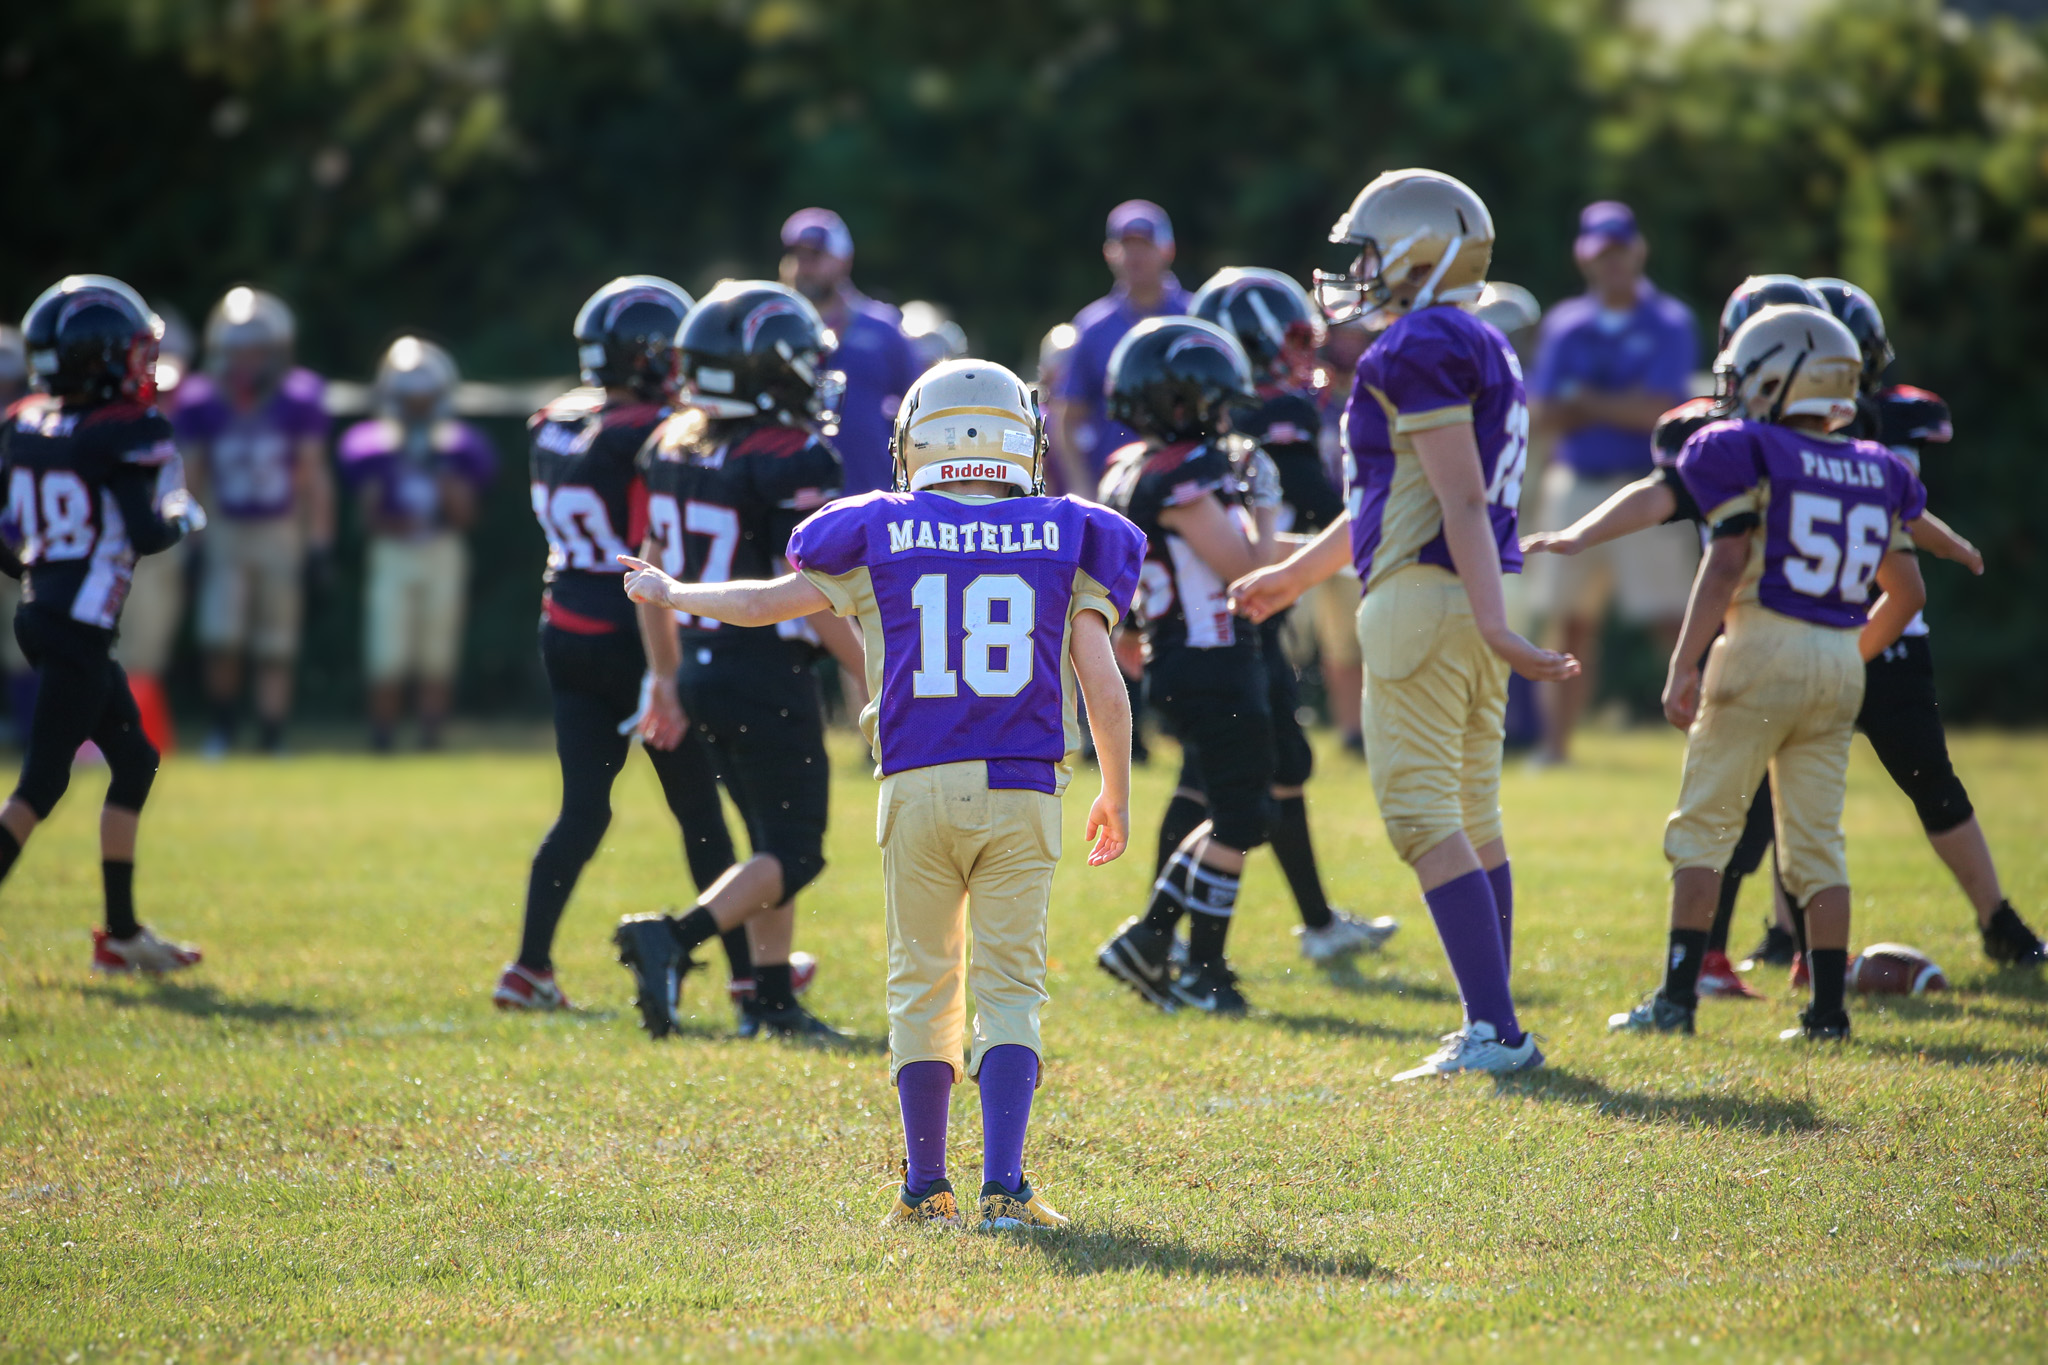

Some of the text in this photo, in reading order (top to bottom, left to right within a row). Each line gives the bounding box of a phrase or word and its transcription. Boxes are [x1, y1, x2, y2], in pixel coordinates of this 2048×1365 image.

[941, 463, 1007, 480] Riddell
[887, 519, 1060, 553] MARTELLO
[1784, 492, 1888, 603] 56
[911, 573, 1035, 698] 18
